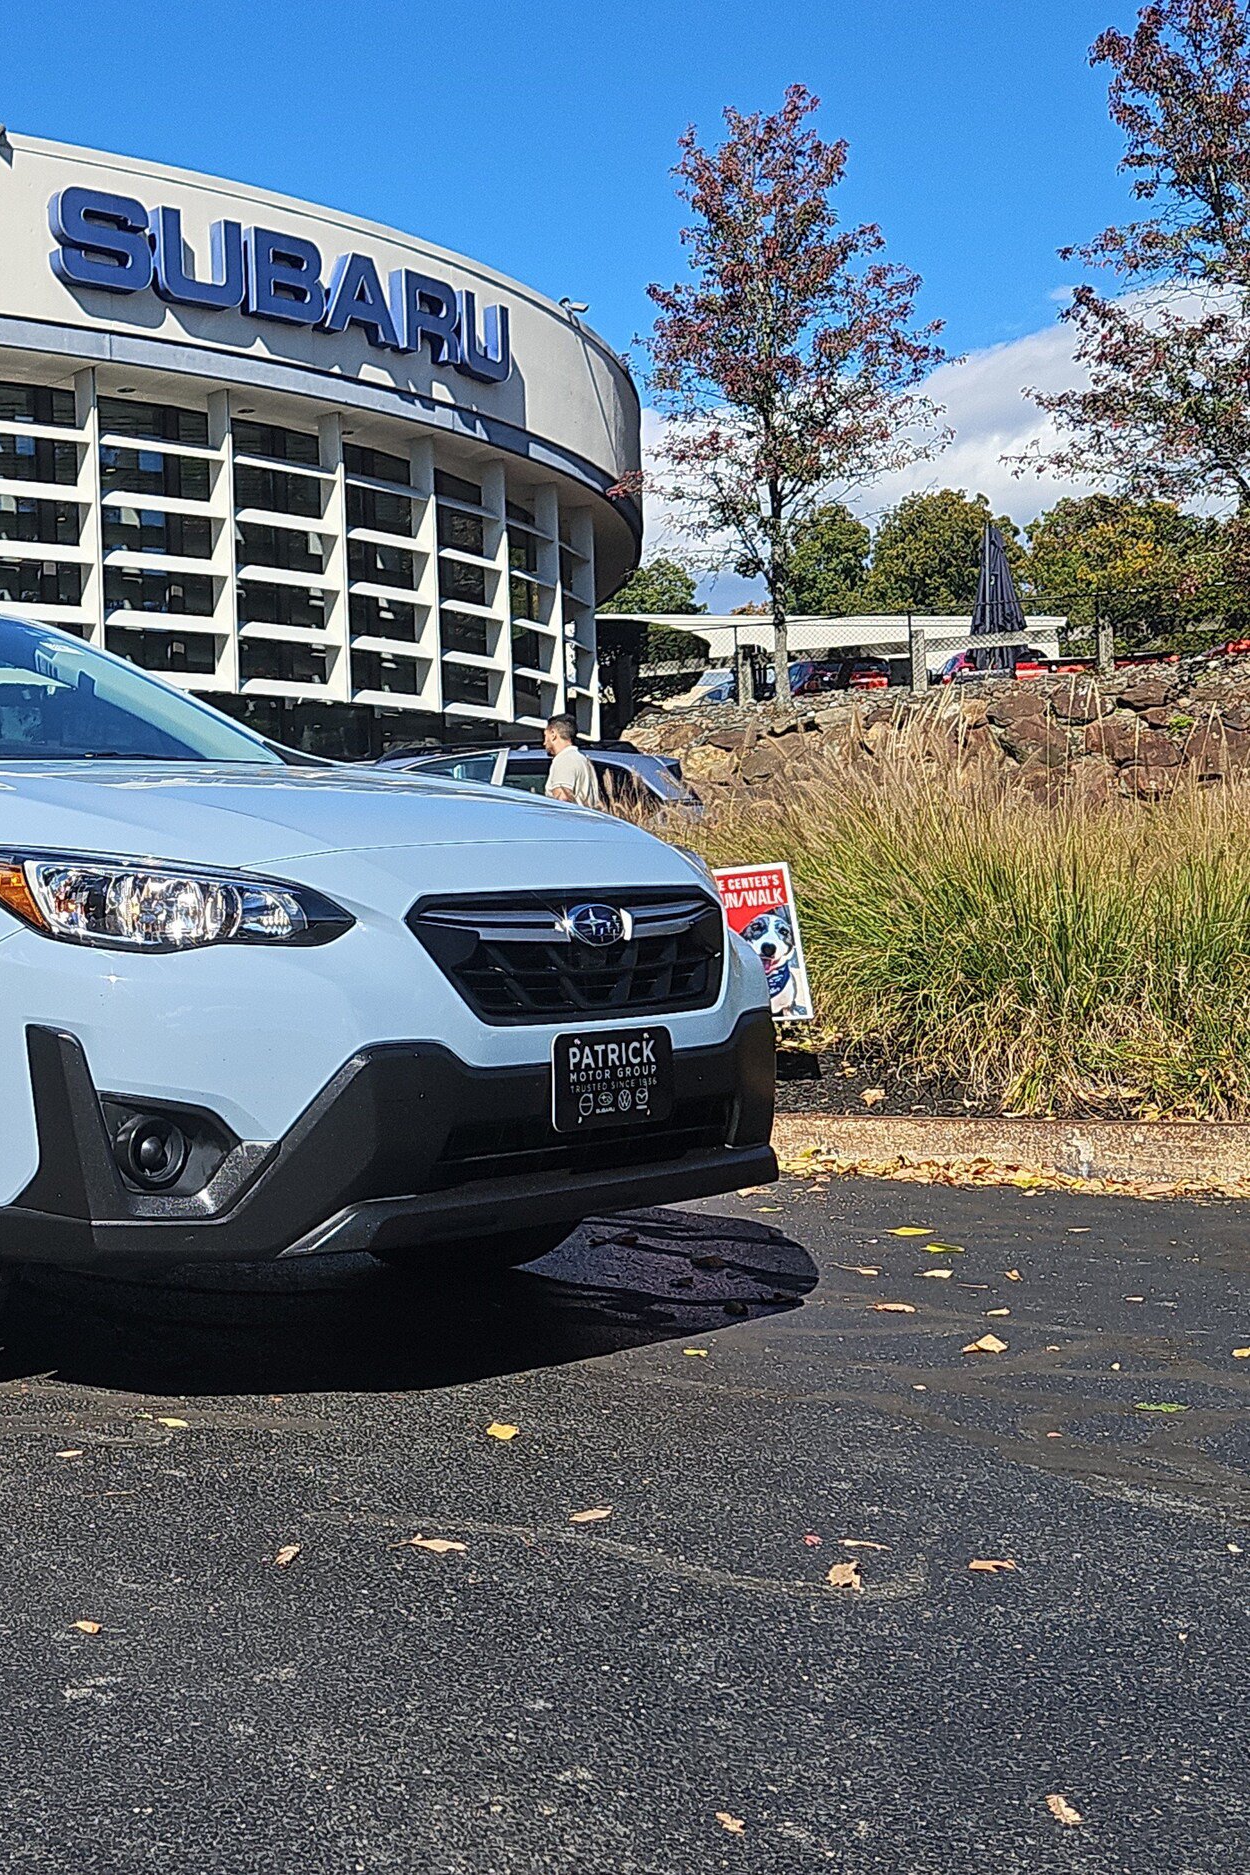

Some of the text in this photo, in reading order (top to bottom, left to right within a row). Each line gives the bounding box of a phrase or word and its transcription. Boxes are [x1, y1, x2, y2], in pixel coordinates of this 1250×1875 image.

[47, 185, 511, 385] SUBARU
[727, 874, 780, 890] CENTER'S
[720, 887, 784, 909] UN/WALK
[569, 1040, 656, 1070] PATRICK
[570, 1065, 657, 1083] MOTOR GROUP
[570, 1082, 608, 1093] TRUSTED
[611, 1078, 635, 1089] SINCE
